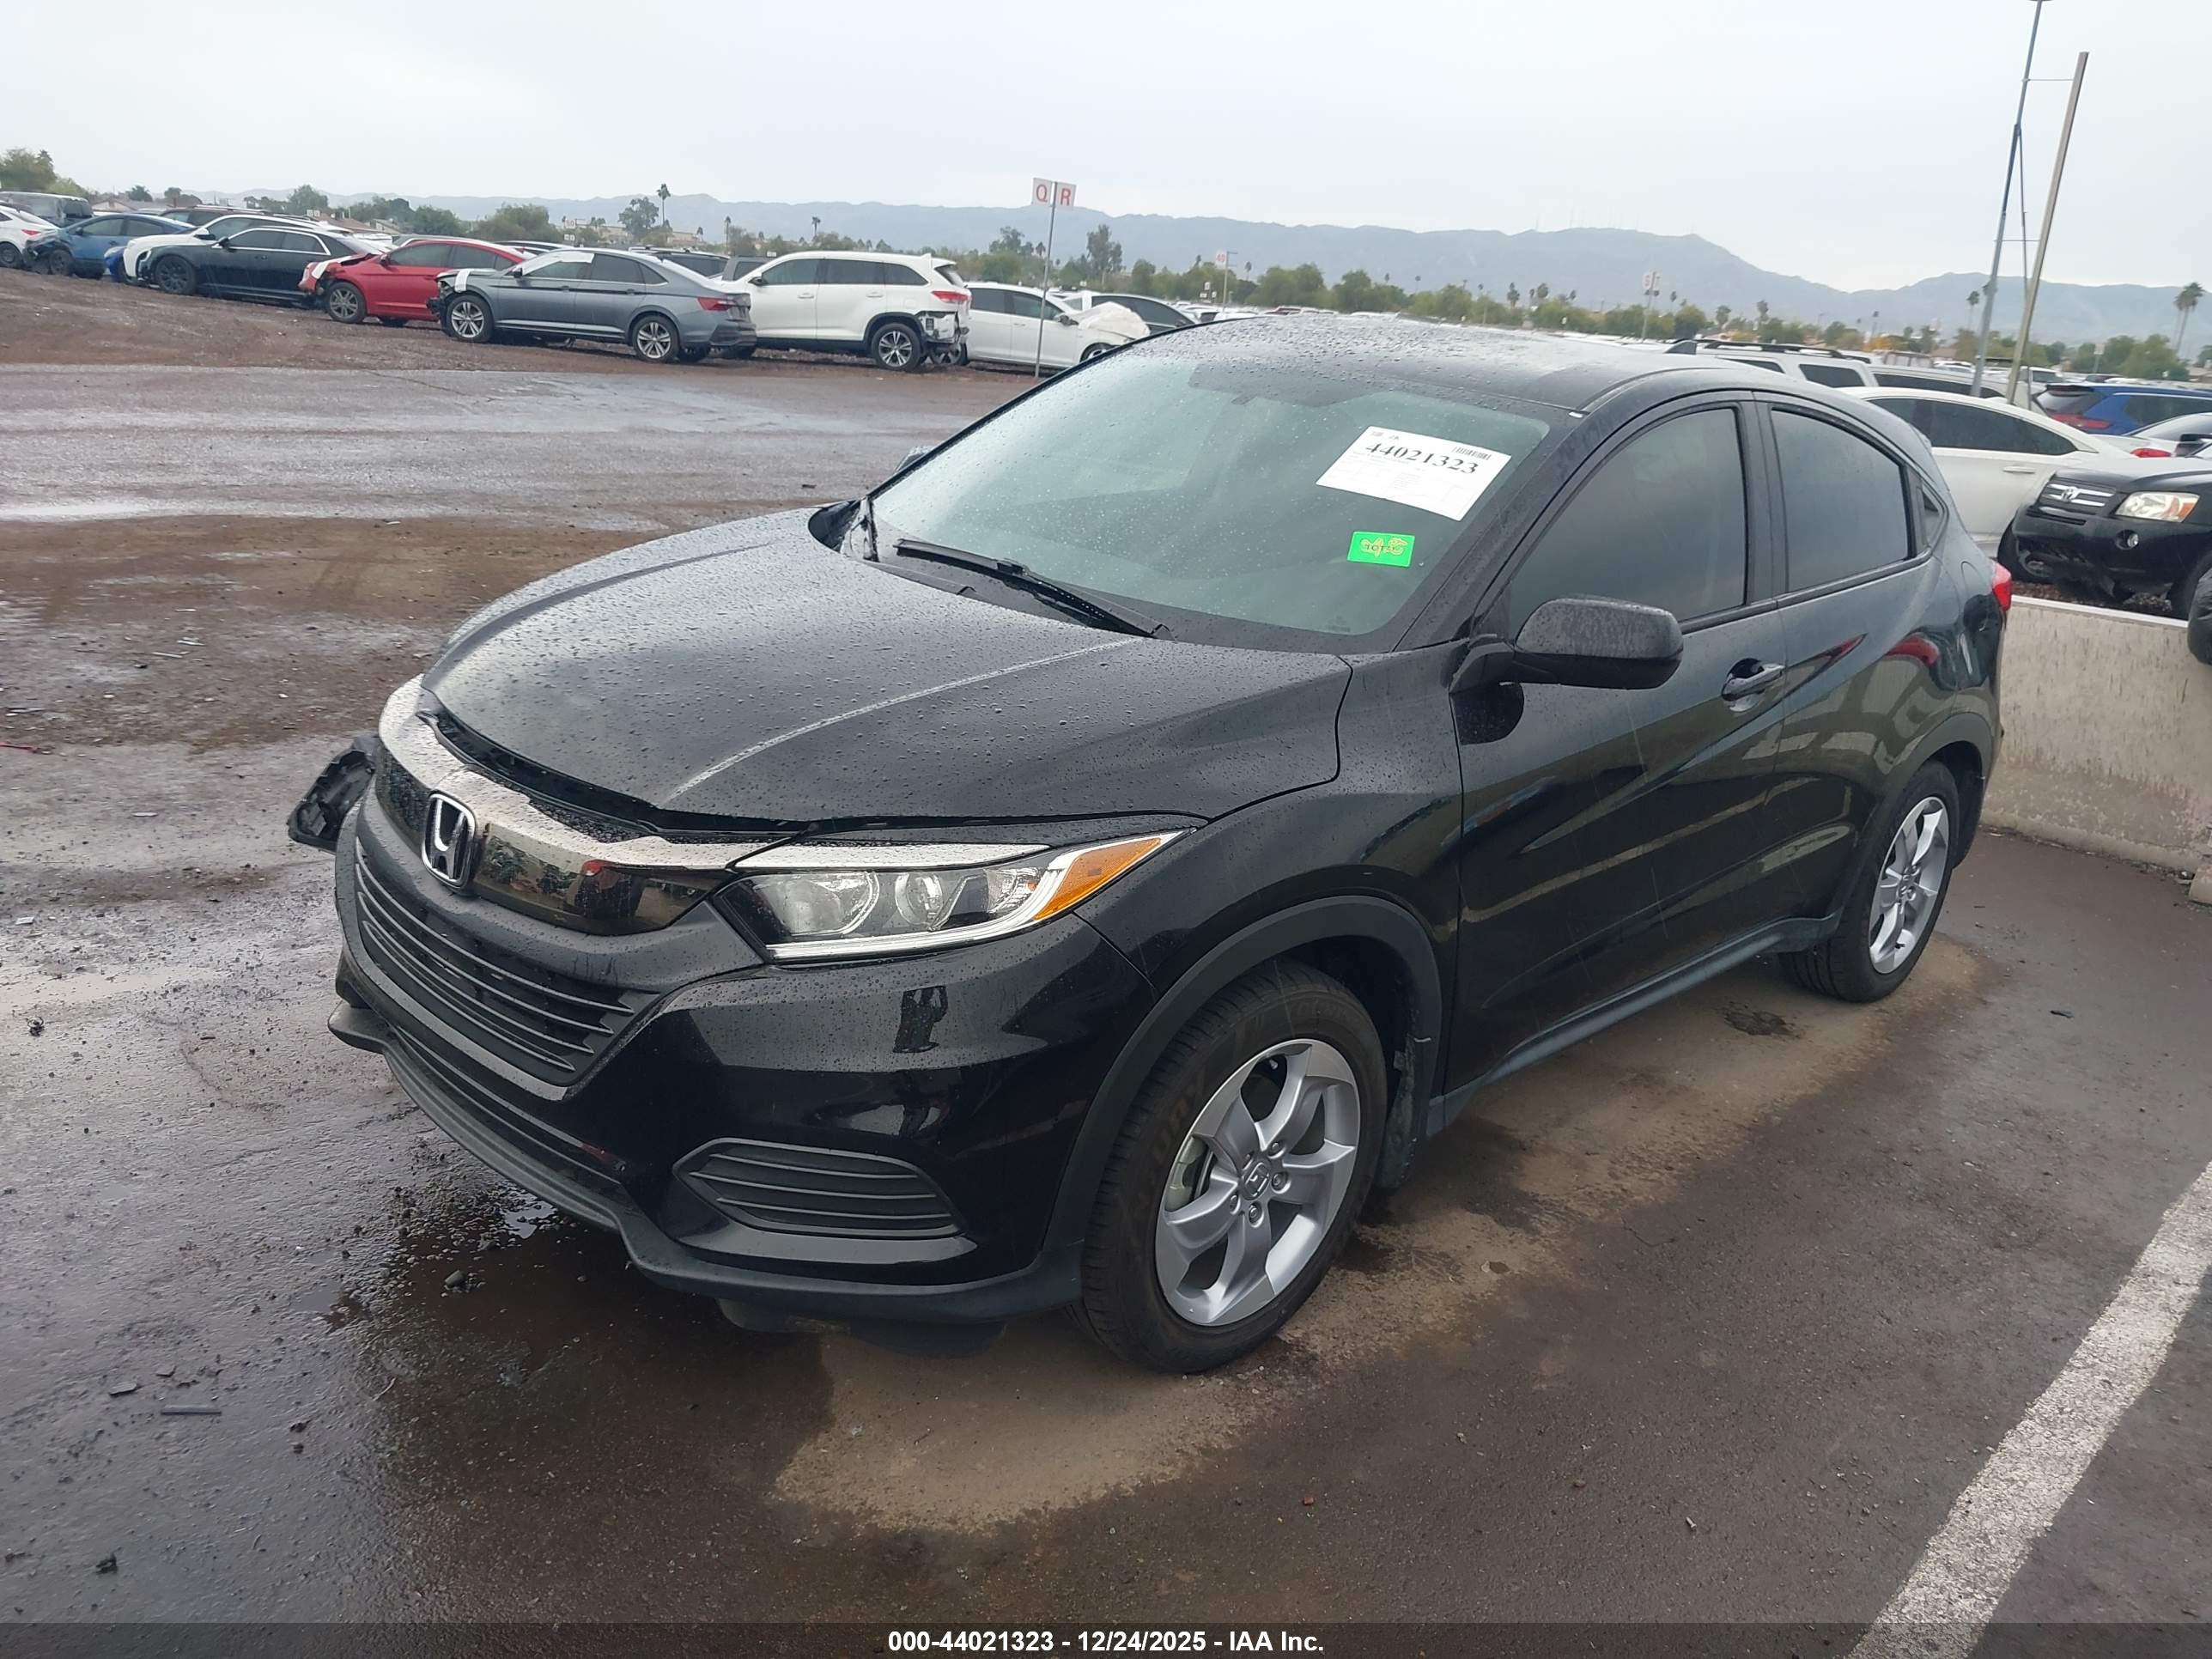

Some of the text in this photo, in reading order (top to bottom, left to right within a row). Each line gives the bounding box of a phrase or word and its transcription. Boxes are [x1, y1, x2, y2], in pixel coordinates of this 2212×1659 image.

[1036, 185, 1048, 202] Q
[1060, 188, 1071, 206] R
[1365, 443, 1479, 474] 44021323
